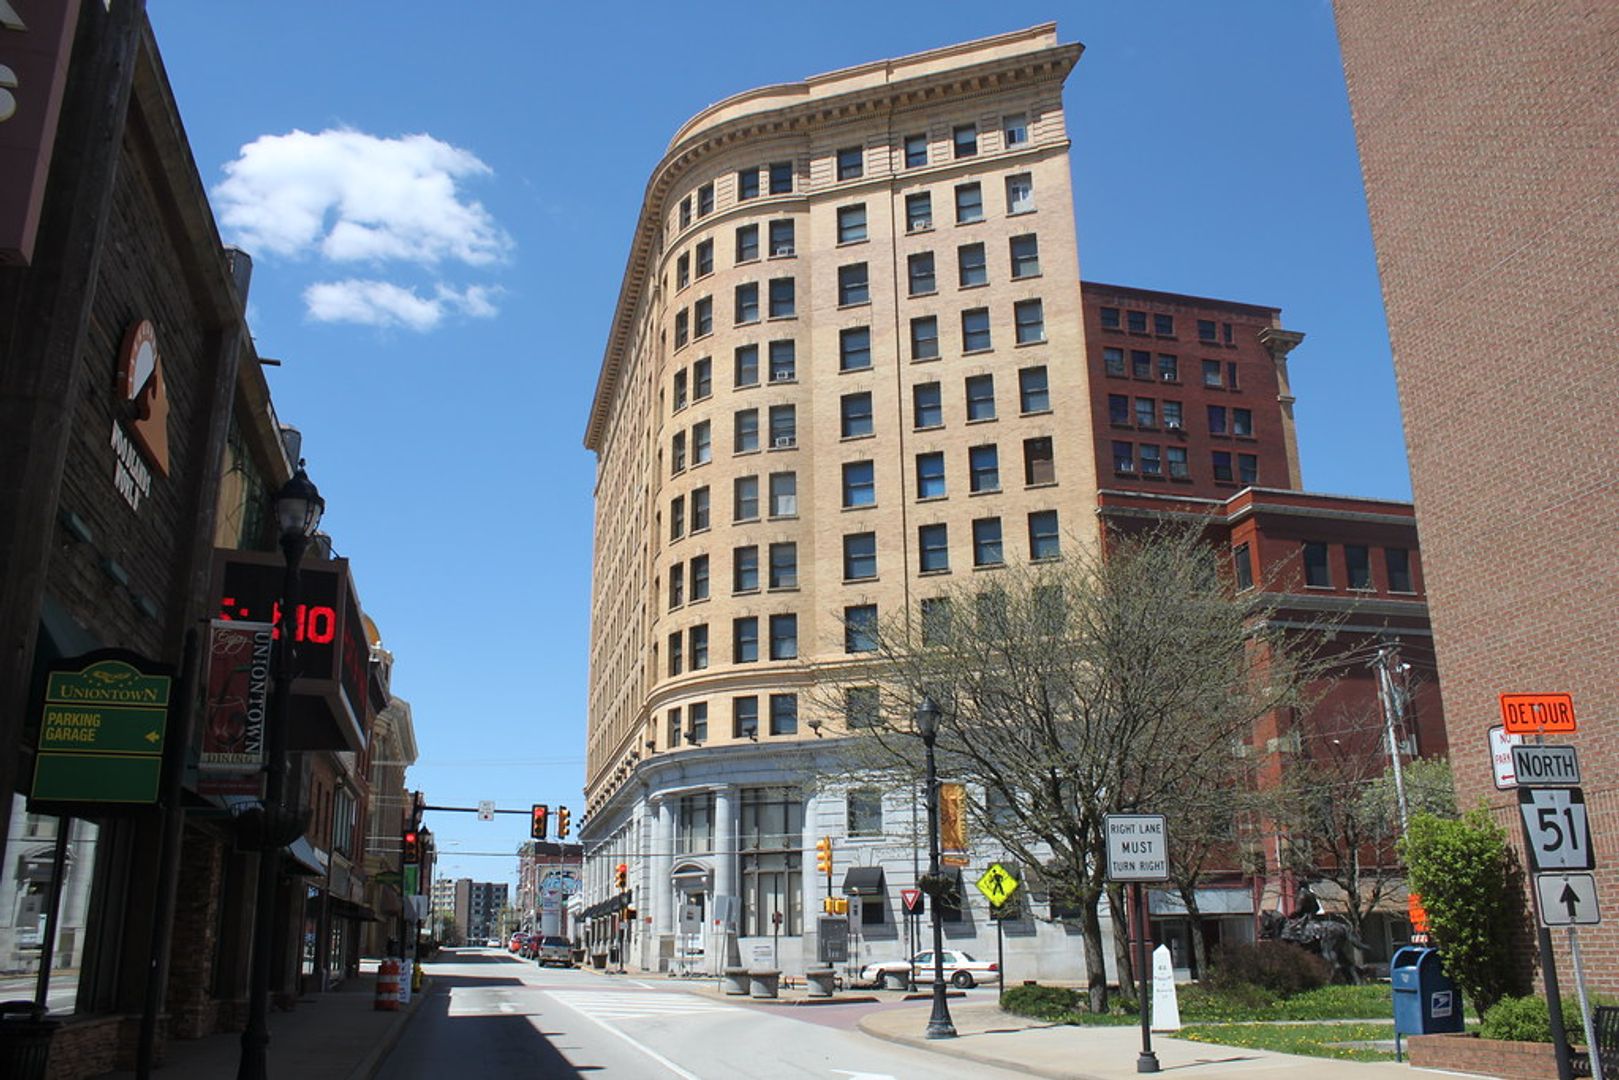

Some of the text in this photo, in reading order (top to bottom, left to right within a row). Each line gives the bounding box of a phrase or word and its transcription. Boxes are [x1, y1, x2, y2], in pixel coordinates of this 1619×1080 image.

[60, 684, 159, 702] UNIONTOWN
[245, 631, 270, 752] UNIONTOWN
[48, 712, 101, 728] PARKING
[1508, 702, 1570, 725] DETOUR
[46, 727, 96, 742] GARAGE
[207, 753, 253, 763] DINING
[1517, 751, 1575, 777] NORTH
[1110, 823, 1162, 834] RIGHT LANE
[1537, 807, 1579, 852] 51
[1122, 841, 1153, 853] MUST
[1113, 860, 1165, 872] TURN RIGHT
